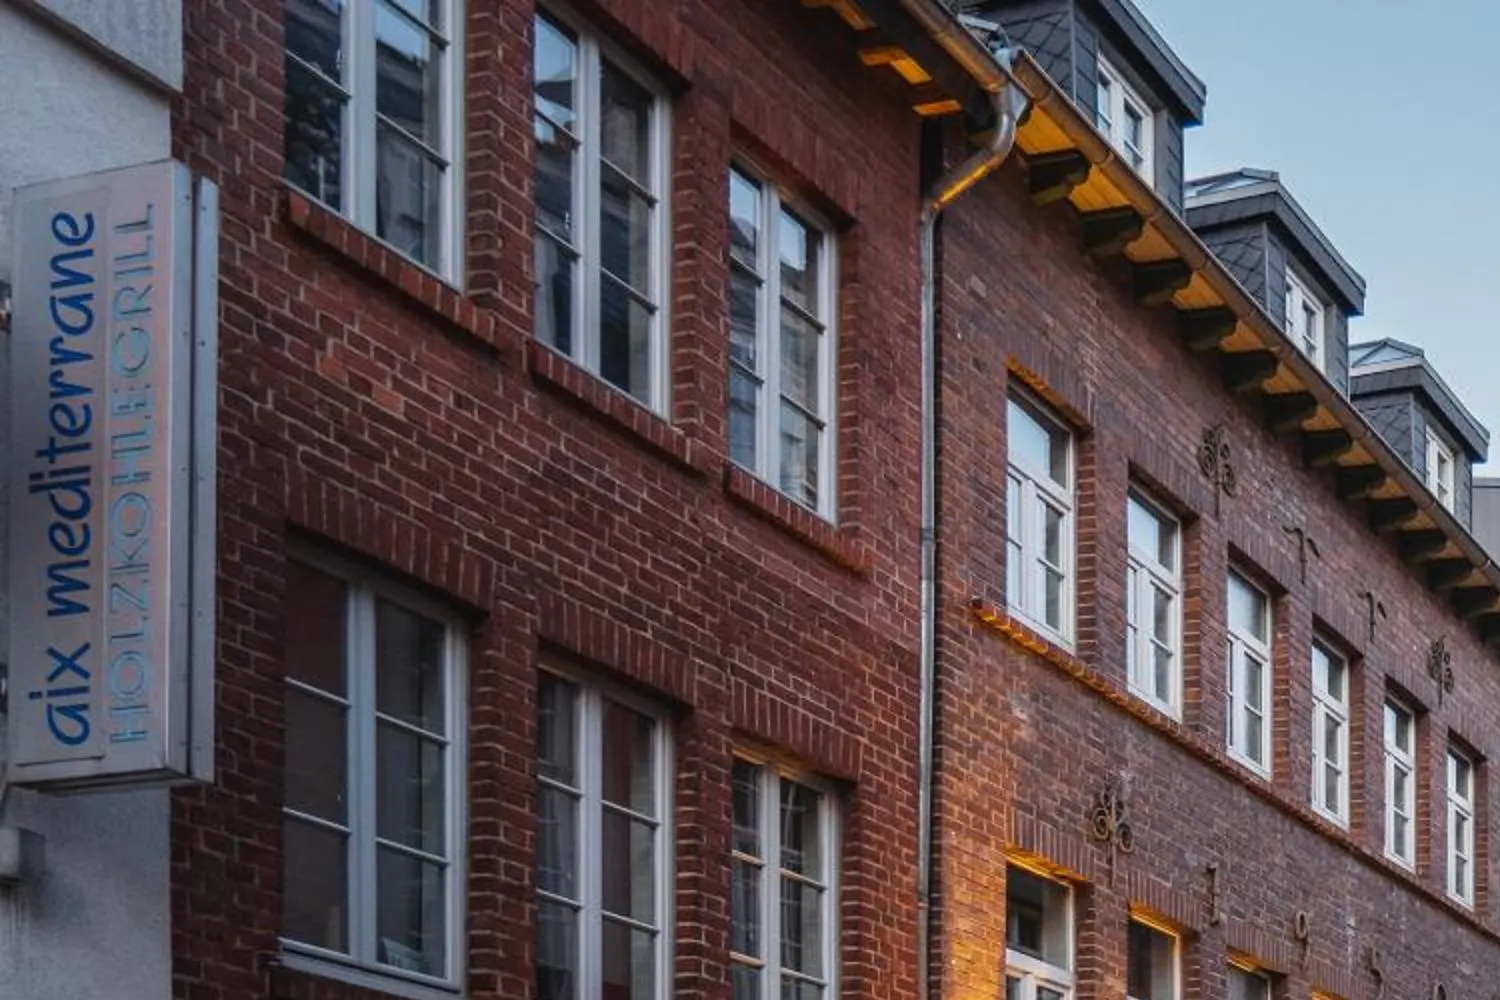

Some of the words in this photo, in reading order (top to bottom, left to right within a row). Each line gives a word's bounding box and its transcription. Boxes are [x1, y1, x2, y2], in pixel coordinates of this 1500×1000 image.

[28, 210, 95, 618] mediterrane
[107, 202, 155, 745] HOLZKOHLEGRILL
[28, 642, 92, 746] aix
